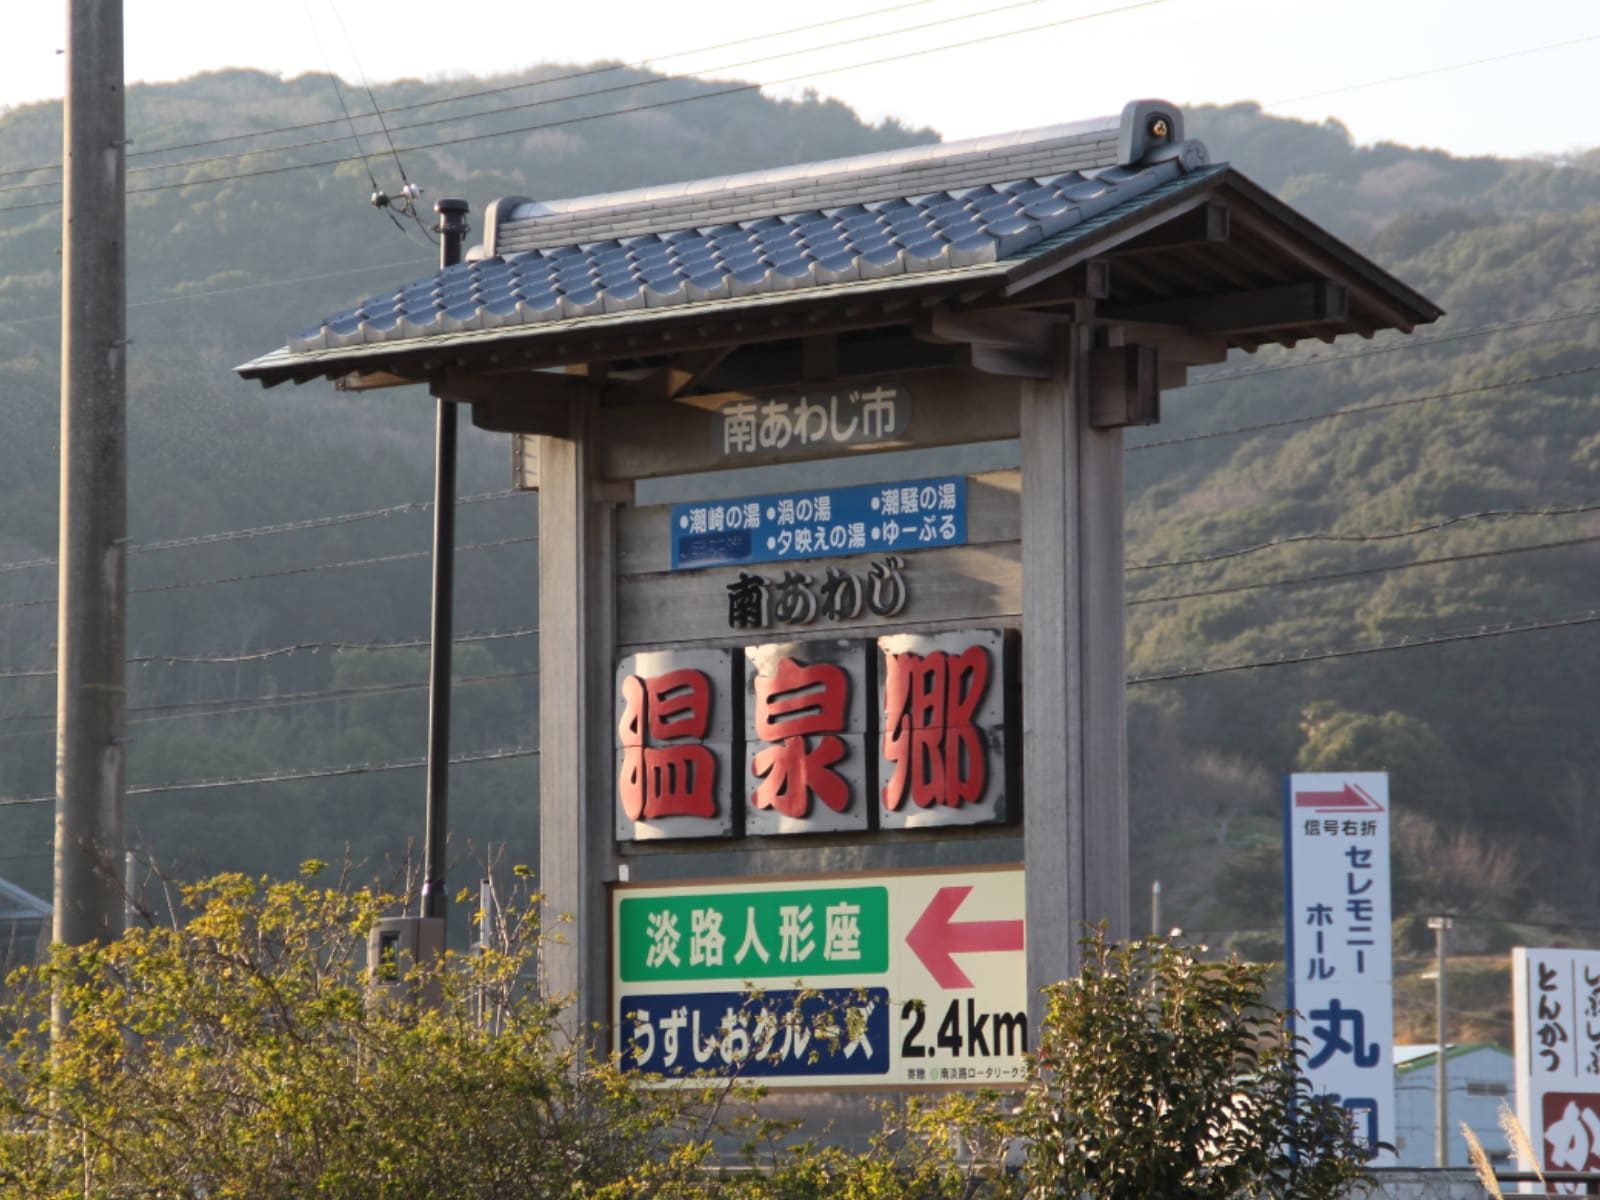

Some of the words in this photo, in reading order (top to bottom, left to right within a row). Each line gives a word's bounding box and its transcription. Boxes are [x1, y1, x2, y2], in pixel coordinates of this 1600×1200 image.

[722, 386, 897, 454] 南あわじ市
[689, 503, 760, 535] 潮崎の湯
[881, 483, 957, 516] 潮騒の湯
[777, 522, 866, 555] 夕映えの湯
[882, 514, 957, 545] ゆーぷる
[726, 556, 908, 628] 南あわじ
[618, 645, 988, 822] 温泉郷
[1304, 820, 1378, 837] 信号右折
[646, 902, 862, 968] 淡路人形座
[1306, 903, 1335, 981] ホール
[1344, 845, 1375, 974] セレモニー
[901, 998, 1028, 1058] 2.4km
[1537, 961, 1568, 1072] とんかつ
